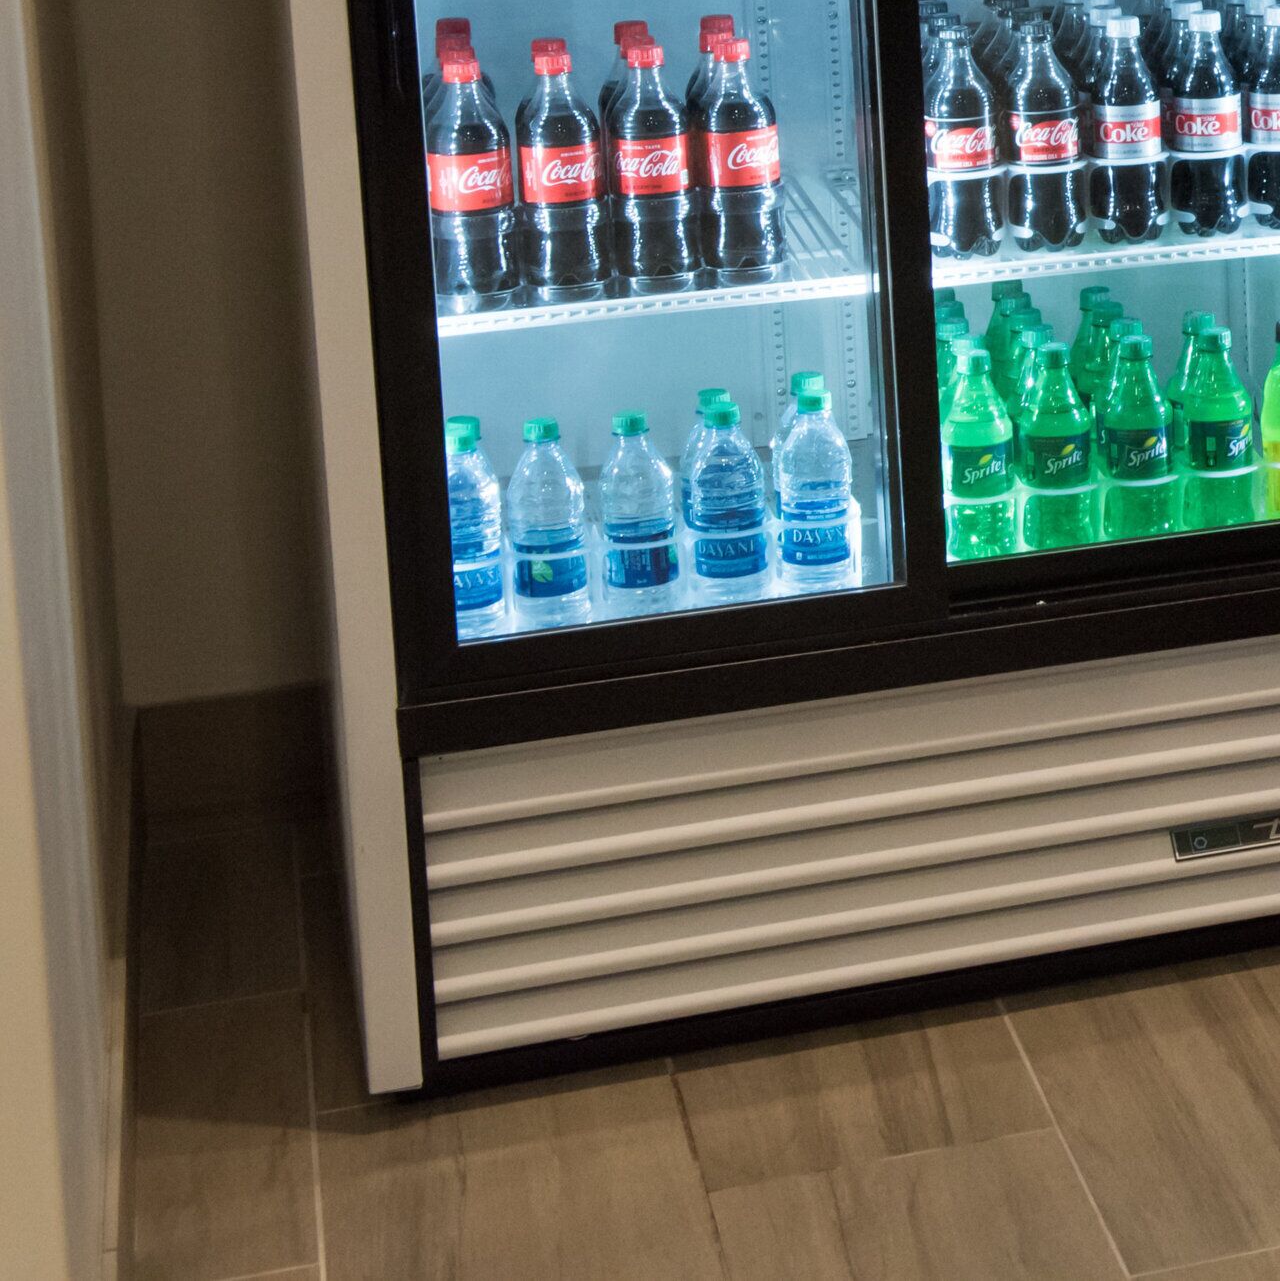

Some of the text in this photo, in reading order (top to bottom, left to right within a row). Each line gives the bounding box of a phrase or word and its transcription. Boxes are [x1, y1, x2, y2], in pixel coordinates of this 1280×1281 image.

[1016, 117, 1080, 147] Coca-Cola
[1099, 123, 1149, 143] Coke
[1175, 114, 1221, 135] Coke
[930, 126, 997, 154] Coca-Cola
[615, 149, 682, 178] Coca-Cola
[1044, 450, 1083, 475] Sprite
[1128, 439, 1167, 467] Sprite
[962, 459, 1002, 485] Sprite
[699, 538, 755, 557] DASANI
